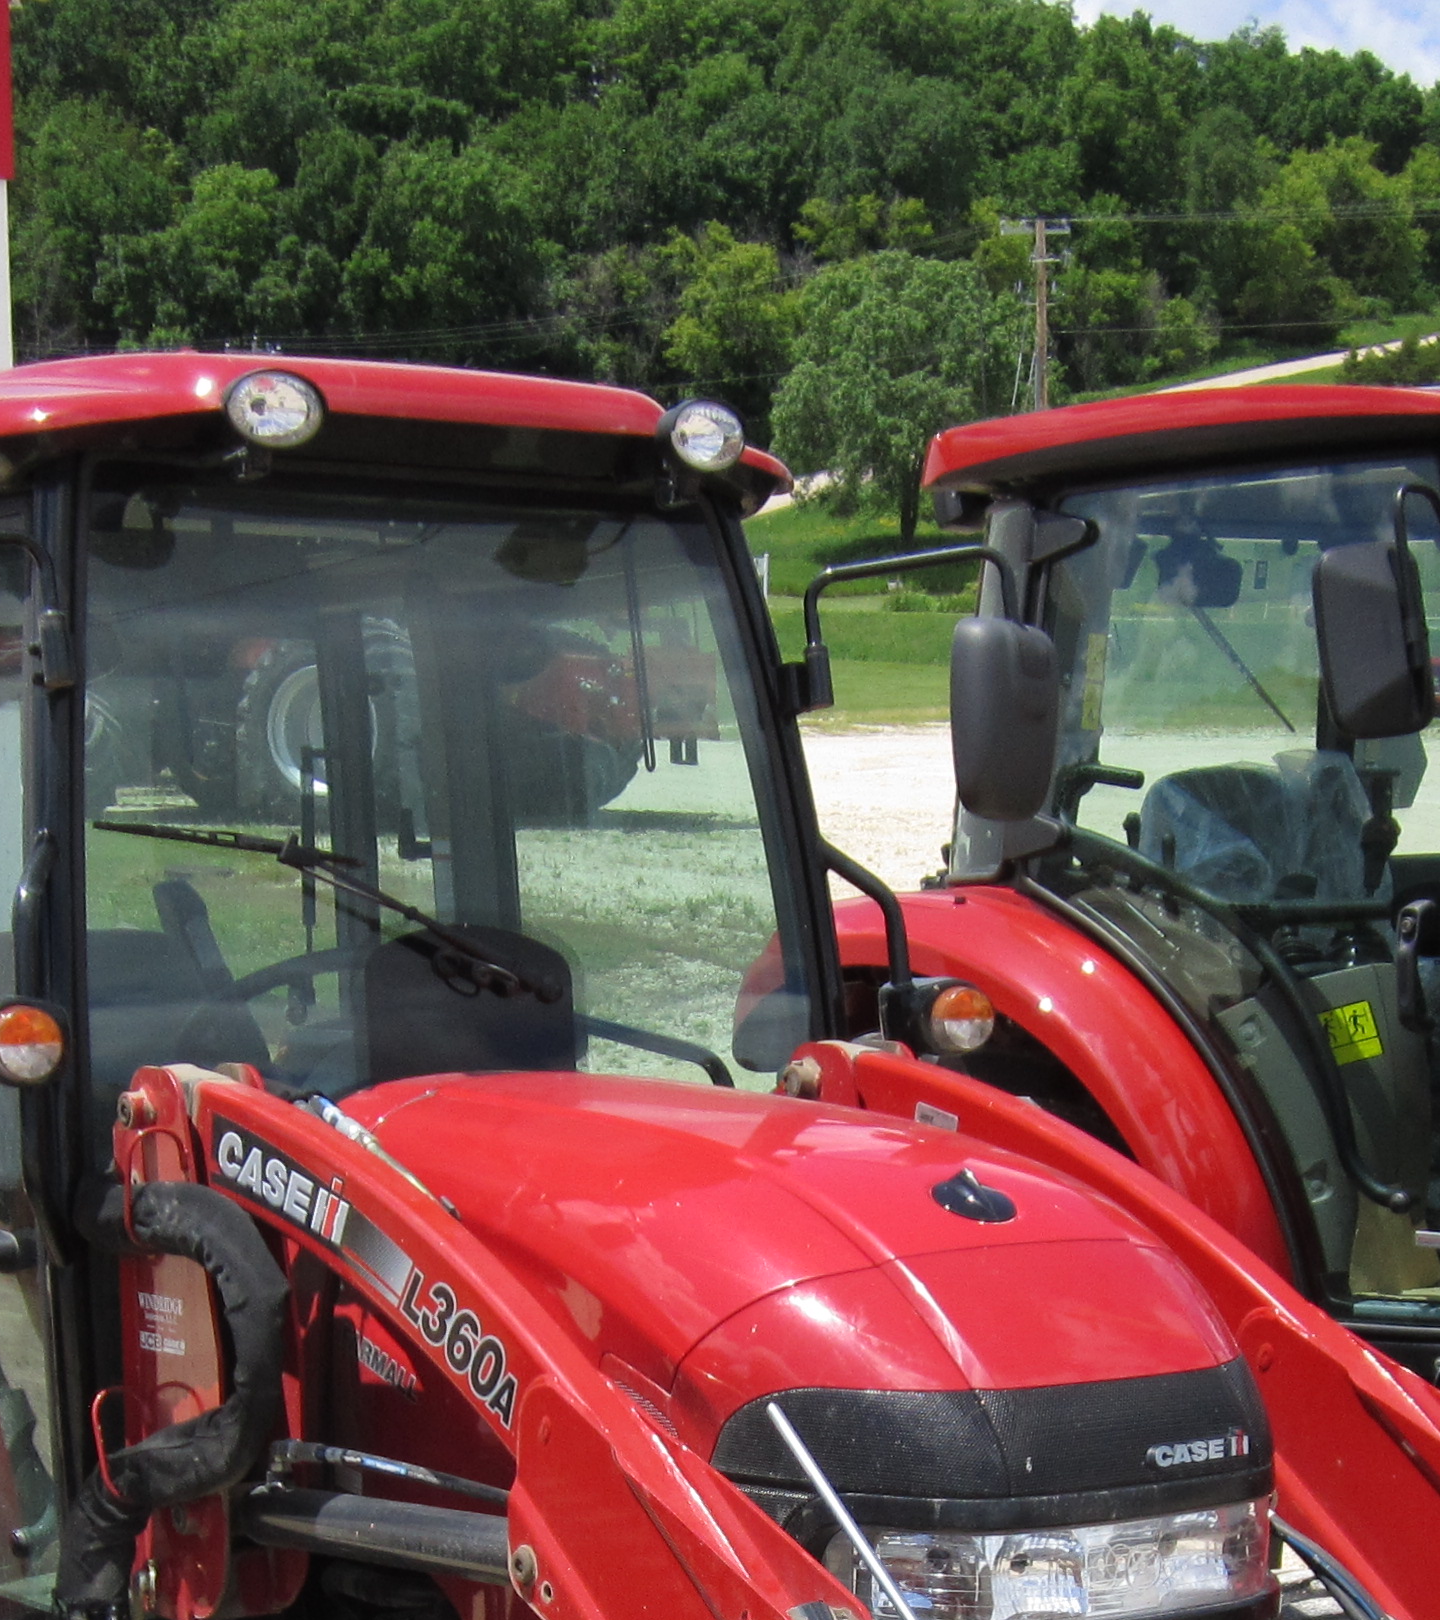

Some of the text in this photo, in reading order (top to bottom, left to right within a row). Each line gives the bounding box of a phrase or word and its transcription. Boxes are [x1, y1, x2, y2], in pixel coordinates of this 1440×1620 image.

[218, 1132, 314, 1225] CASE
[399, 1267, 518, 1431] L360A
[1155, 1437, 1224, 1467] CASE
